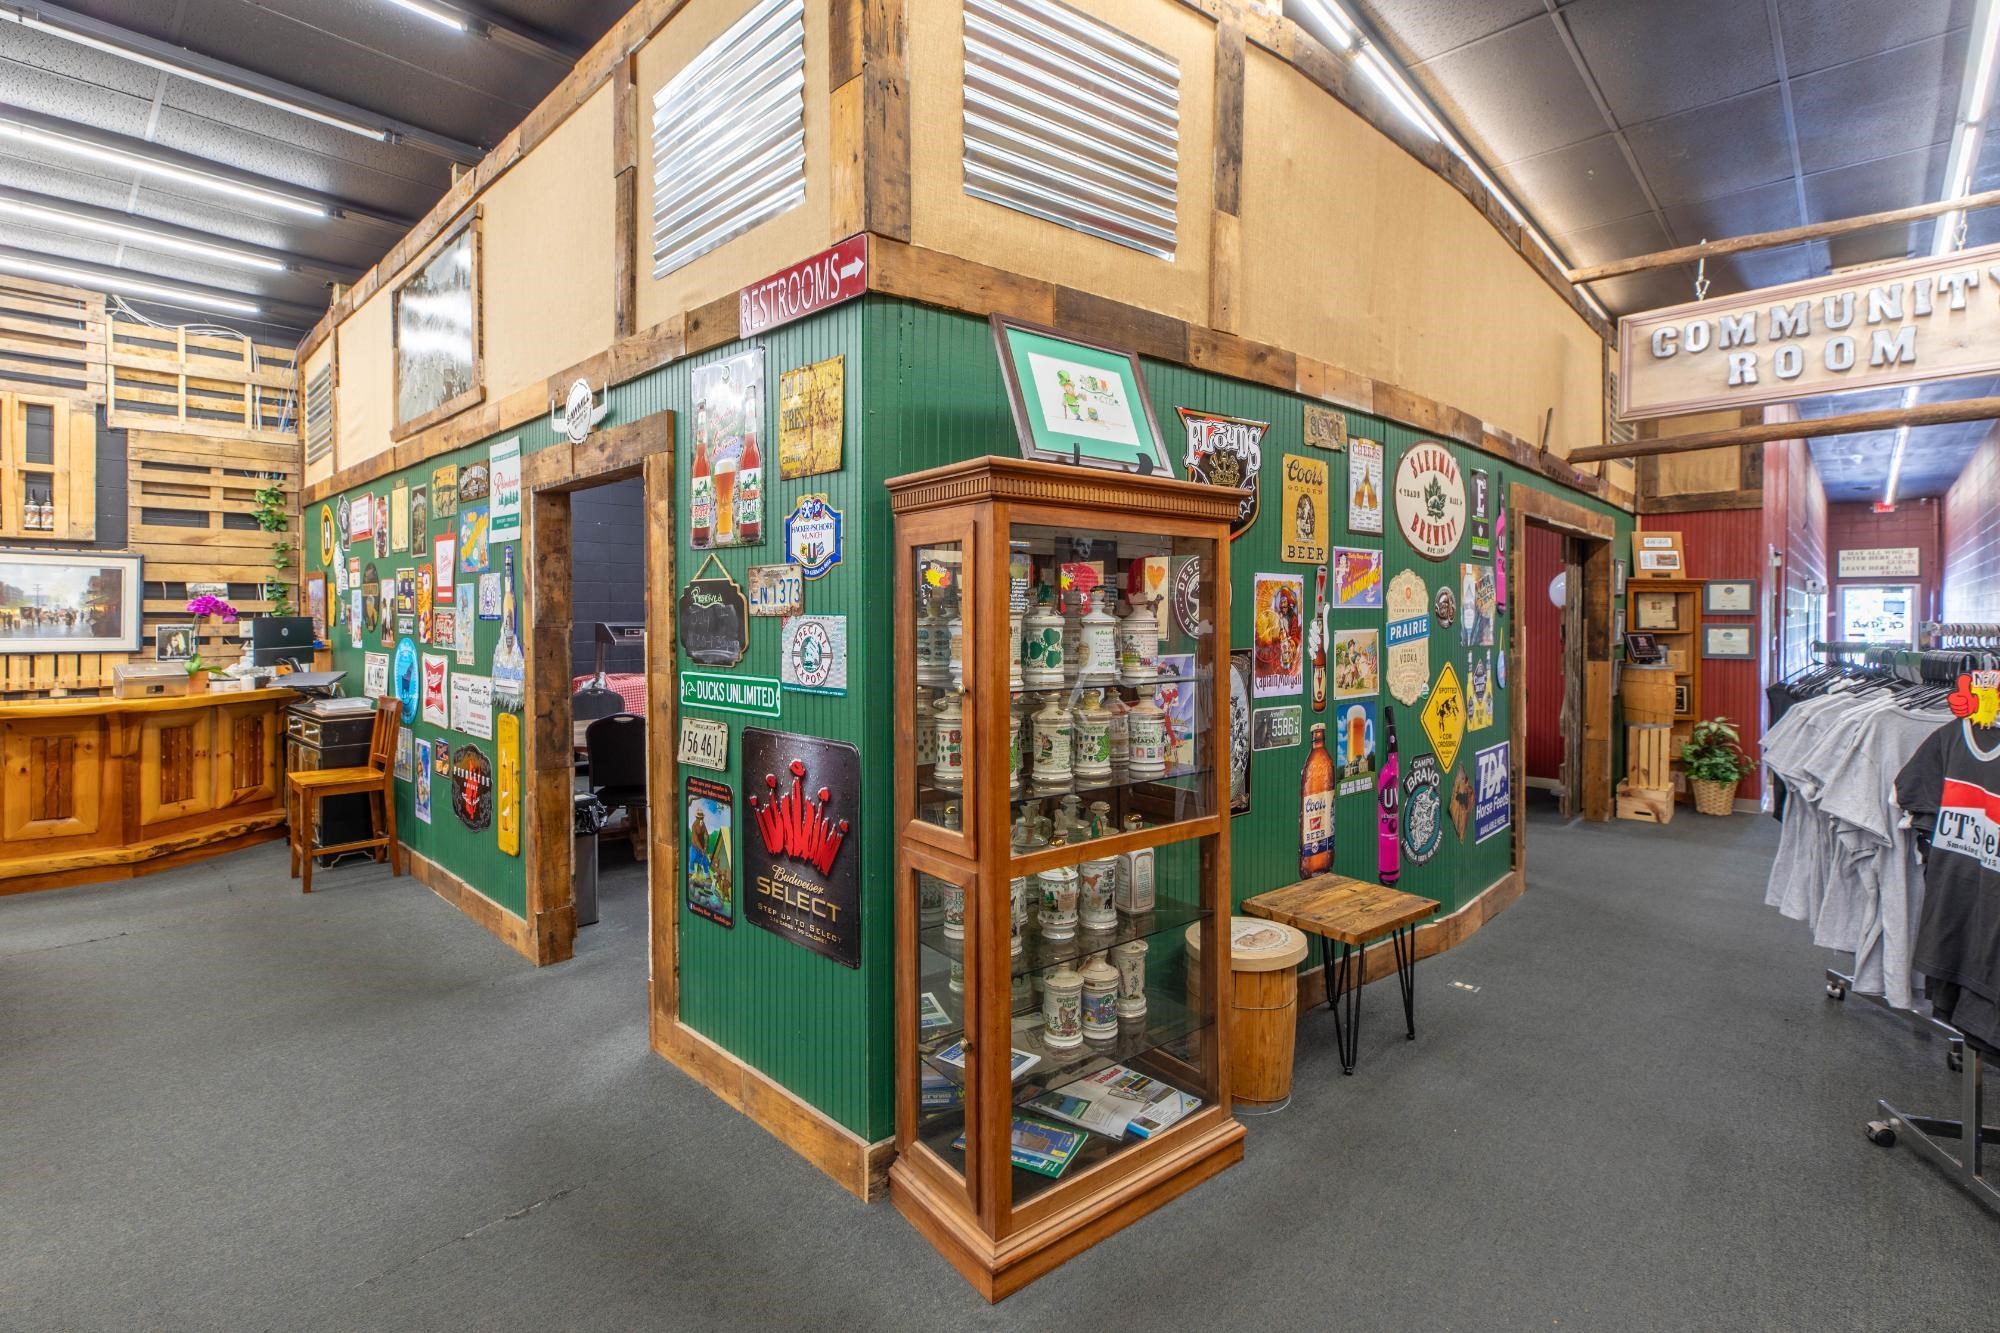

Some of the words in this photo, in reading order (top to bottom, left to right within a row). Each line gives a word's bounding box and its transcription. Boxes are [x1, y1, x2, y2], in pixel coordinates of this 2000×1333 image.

[740, 252, 841, 332] RESTROOMS
[1651, 266, 2000, 359] COMMUNIT
[1728, 325, 1917, 386] ROOM
[1287, 459, 1323, 486] Coors
[1410, 450, 1455, 485] SLEEMAN
[1287, 485, 1323, 495] GOLDEN
[1411, 512, 1457, 546] BREWERY
[1287, 545, 1324, 561] BEER
[794, 625, 827, 648] SPECIAL
[1390, 619, 1428, 640] PRAIRIE
[1400, 654, 1418, 664] VODKA
[795, 663, 826, 684] EXPORT
[1255, 674, 1280, 691] Captain
[1279, 674, 1302, 689] Morgan
[697, 681, 725, 702] DUCKS
[727, 684, 774, 707] UNLIMITED
[1413, 757, 1434, 769] CAMPO
[1407, 767, 1440, 793] BRAVO
[1305, 797, 1327, 813] Coors
[1476, 804, 1493, 820] Horse
[1493, 793, 1509, 810] Feeds
[1306, 829, 1326, 841] BEER
[1480, 821, 1495, 836] AVAILABLE
[1939, 810, 1980, 846] CT's
[771, 864, 824, 894] Budweiser
[756, 876, 841, 922] SELECT
[757, 902, 777, 915] STEP
[781, 913, 791, 921] UP
[795, 918, 805, 928] TO
